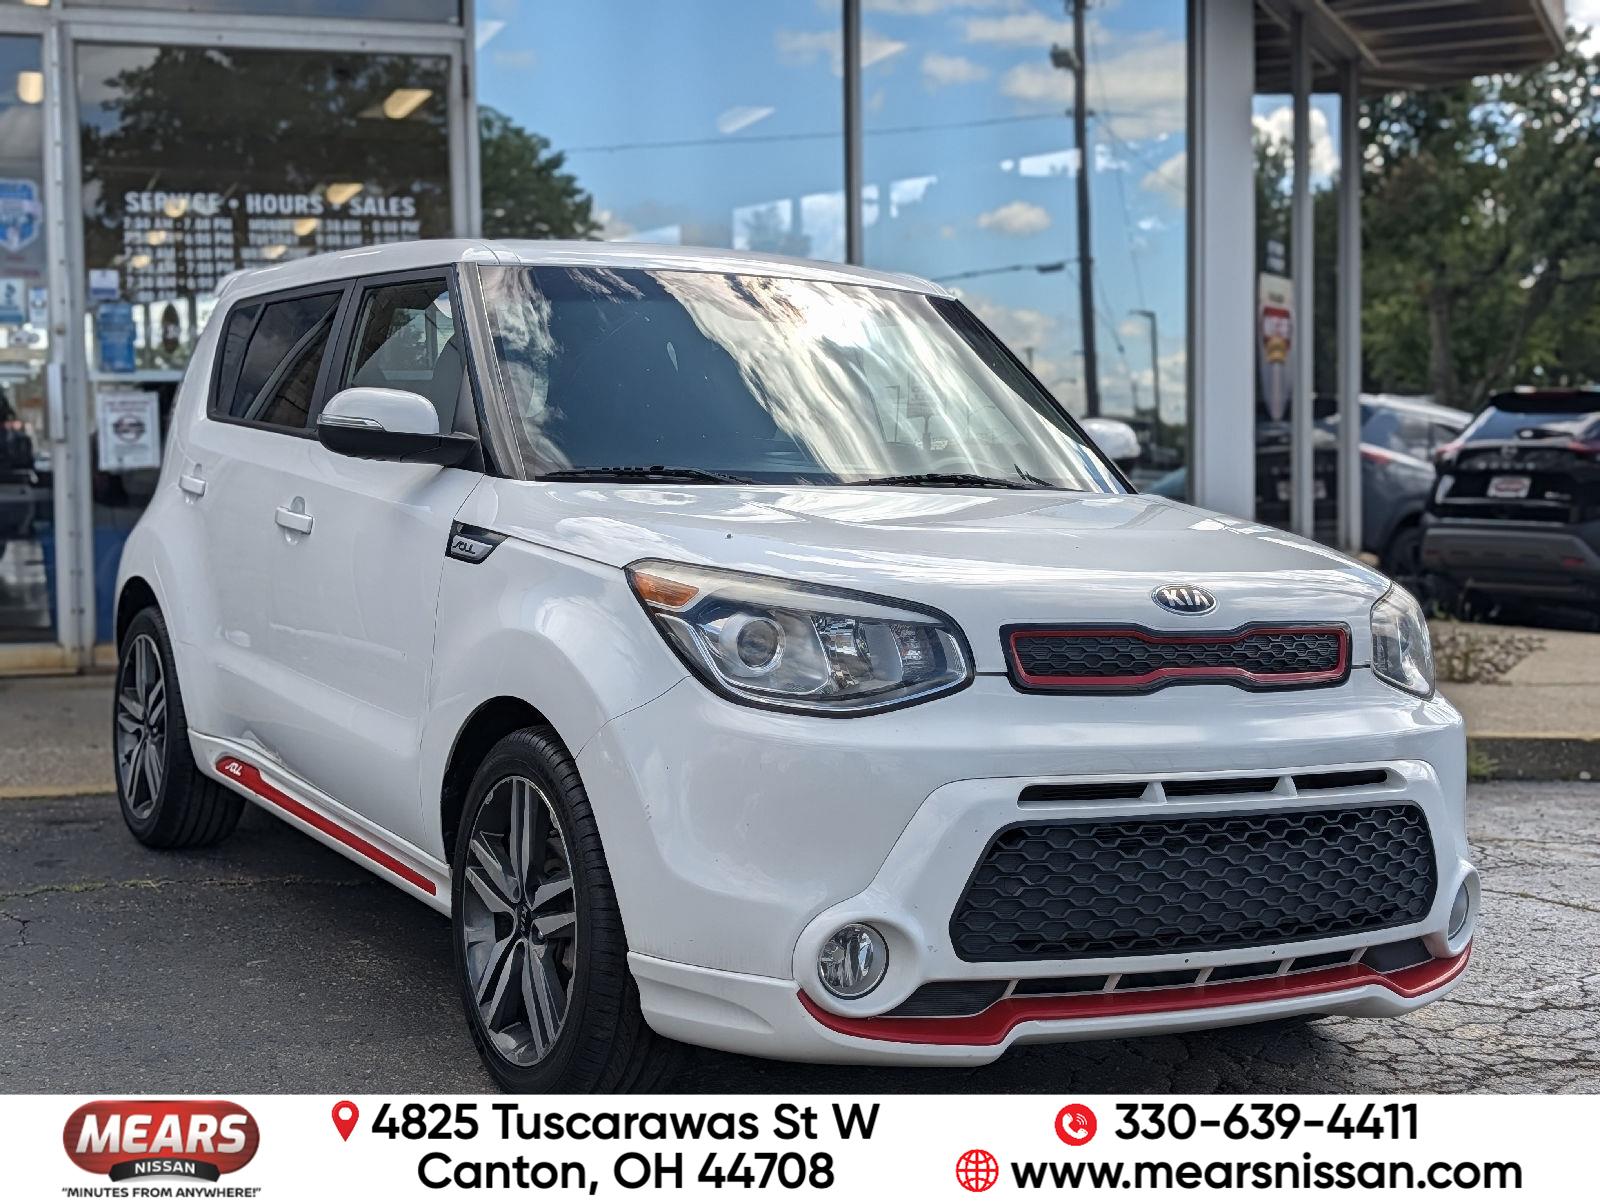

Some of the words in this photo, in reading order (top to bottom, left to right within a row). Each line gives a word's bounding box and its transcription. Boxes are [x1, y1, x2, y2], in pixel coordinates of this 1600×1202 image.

[246, 194, 324, 215] HOURS
[349, 197, 416, 217] SALES
[1161, 588, 1211, 607] KIA
